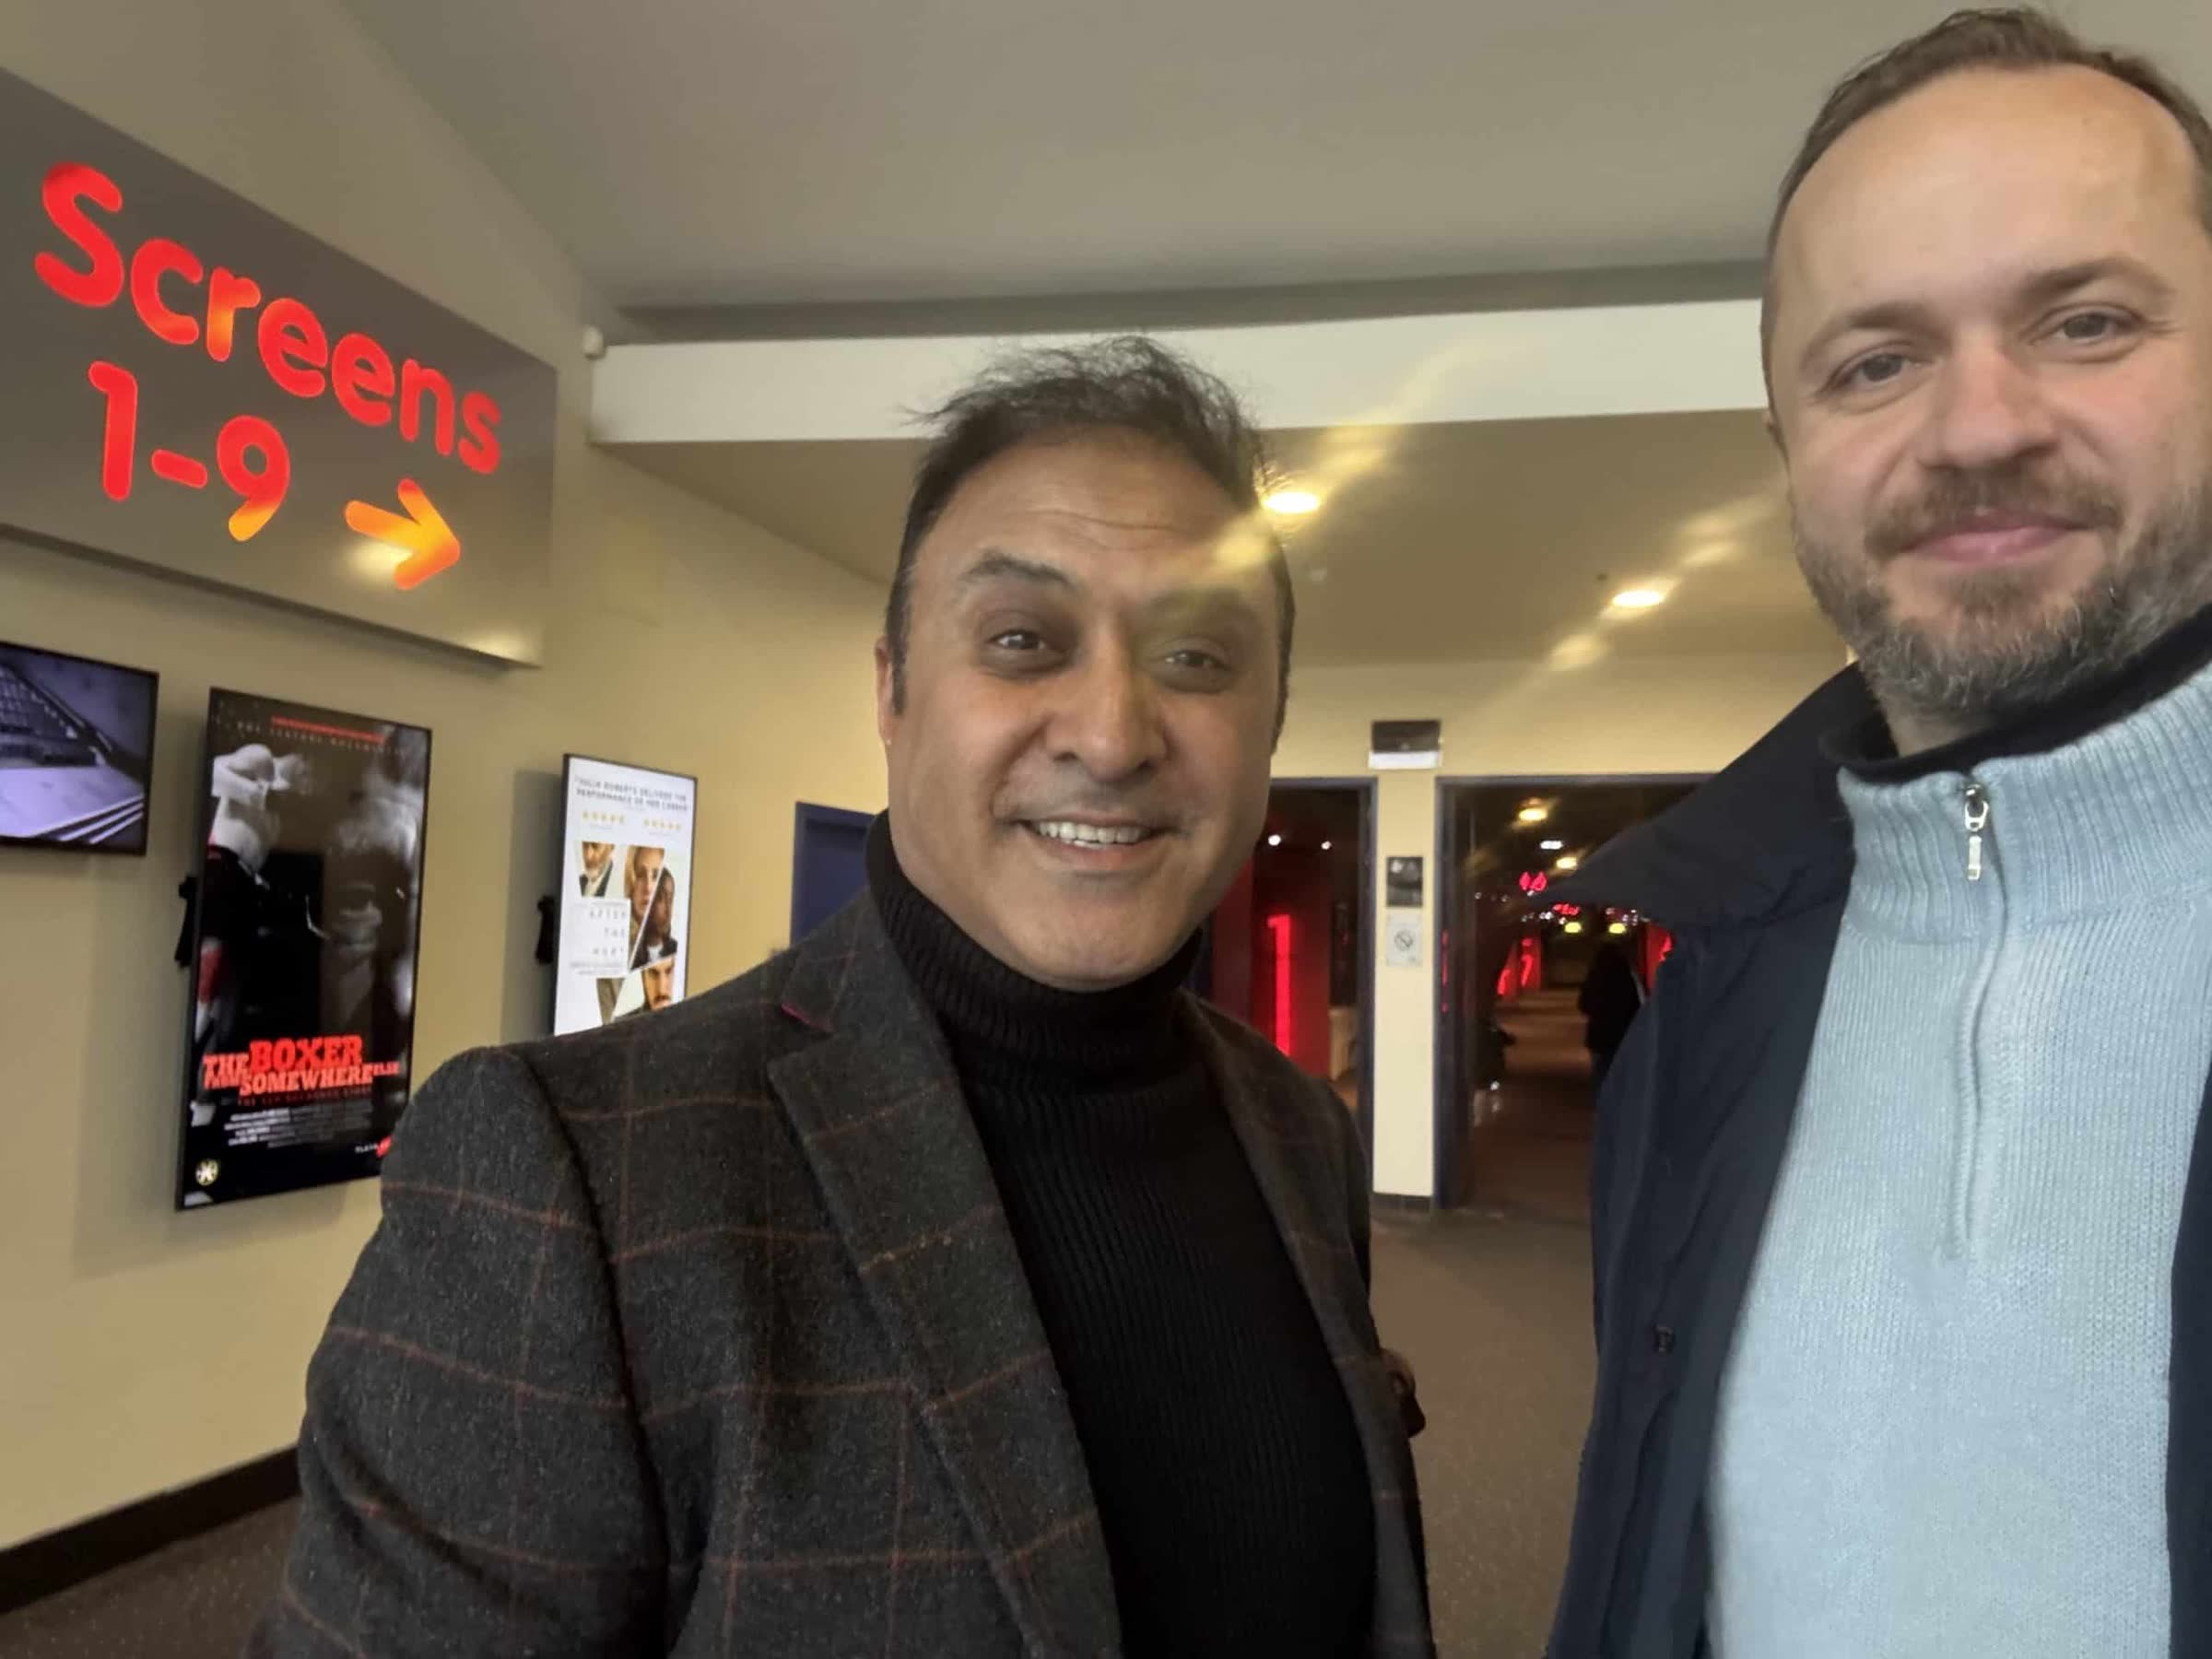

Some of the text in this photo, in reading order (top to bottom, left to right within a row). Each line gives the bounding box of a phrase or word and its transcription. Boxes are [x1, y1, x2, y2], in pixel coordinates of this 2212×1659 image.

[34, 161, 501, 475] Screens
[88, 360, 290, 542] 1-9
[203, 1035, 362, 1075] THE BOXER
[1267, 914, 1290, 1057] 1
[239, 1064, 373, 1097] SOMEWHERE
